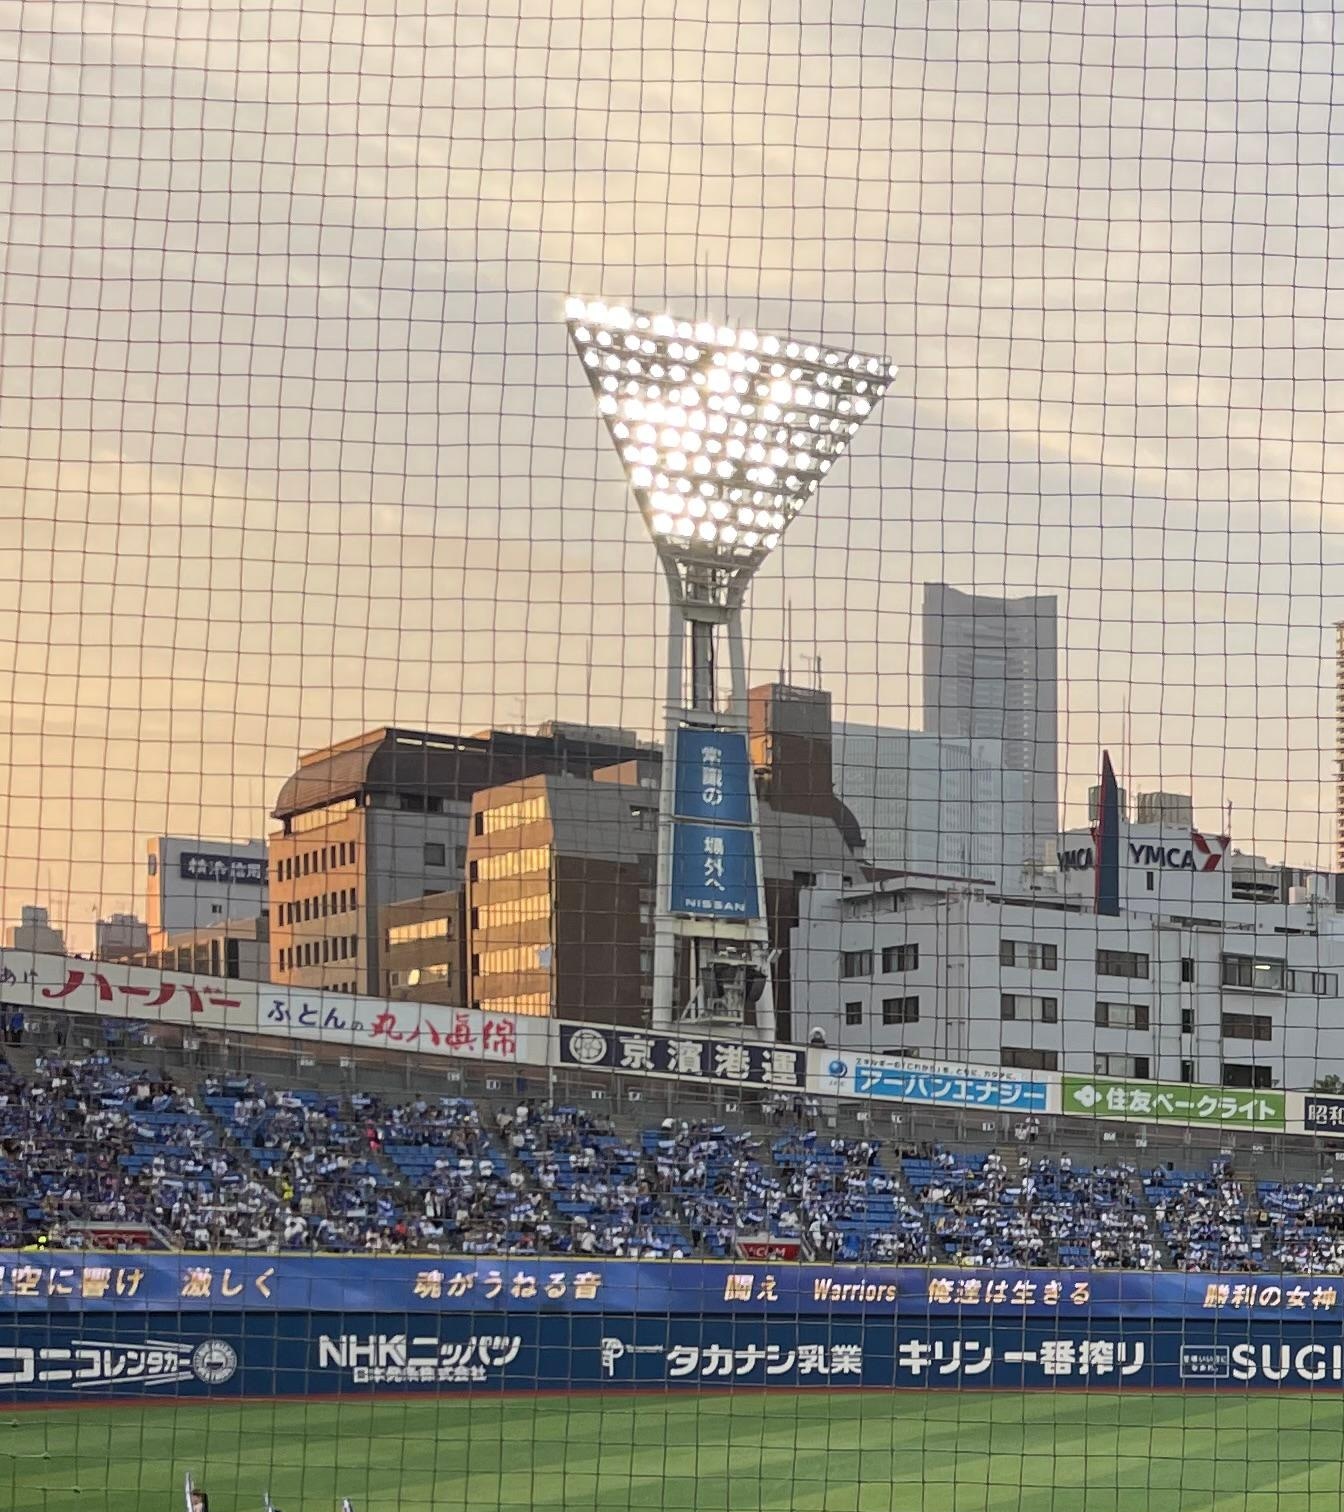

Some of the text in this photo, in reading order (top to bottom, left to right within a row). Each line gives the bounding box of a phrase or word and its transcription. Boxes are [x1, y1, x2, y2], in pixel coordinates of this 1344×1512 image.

[1130, 843, 1196, 871] YMCA
[685, 898, 745, 912] NISSAN
[42, 970, 241, 1012] ハーバー
[859, 1069, 1045, 1105] アーバンエナジー
[1106, 1087, 1276, 1121] 住友ベークライト
[0, 1265, 144, 1298] 空に響け
[413, 1269, 601, 1300] 魂がうねる音
[814, 1277, 898, 1302] Warriors
[928, 1277, 1090, 1306] 俺達は生きる
[1203, 1284, 1338, 1311] 勝利の女神
[666, 1343, 863, 1377] タカナシ乳業
